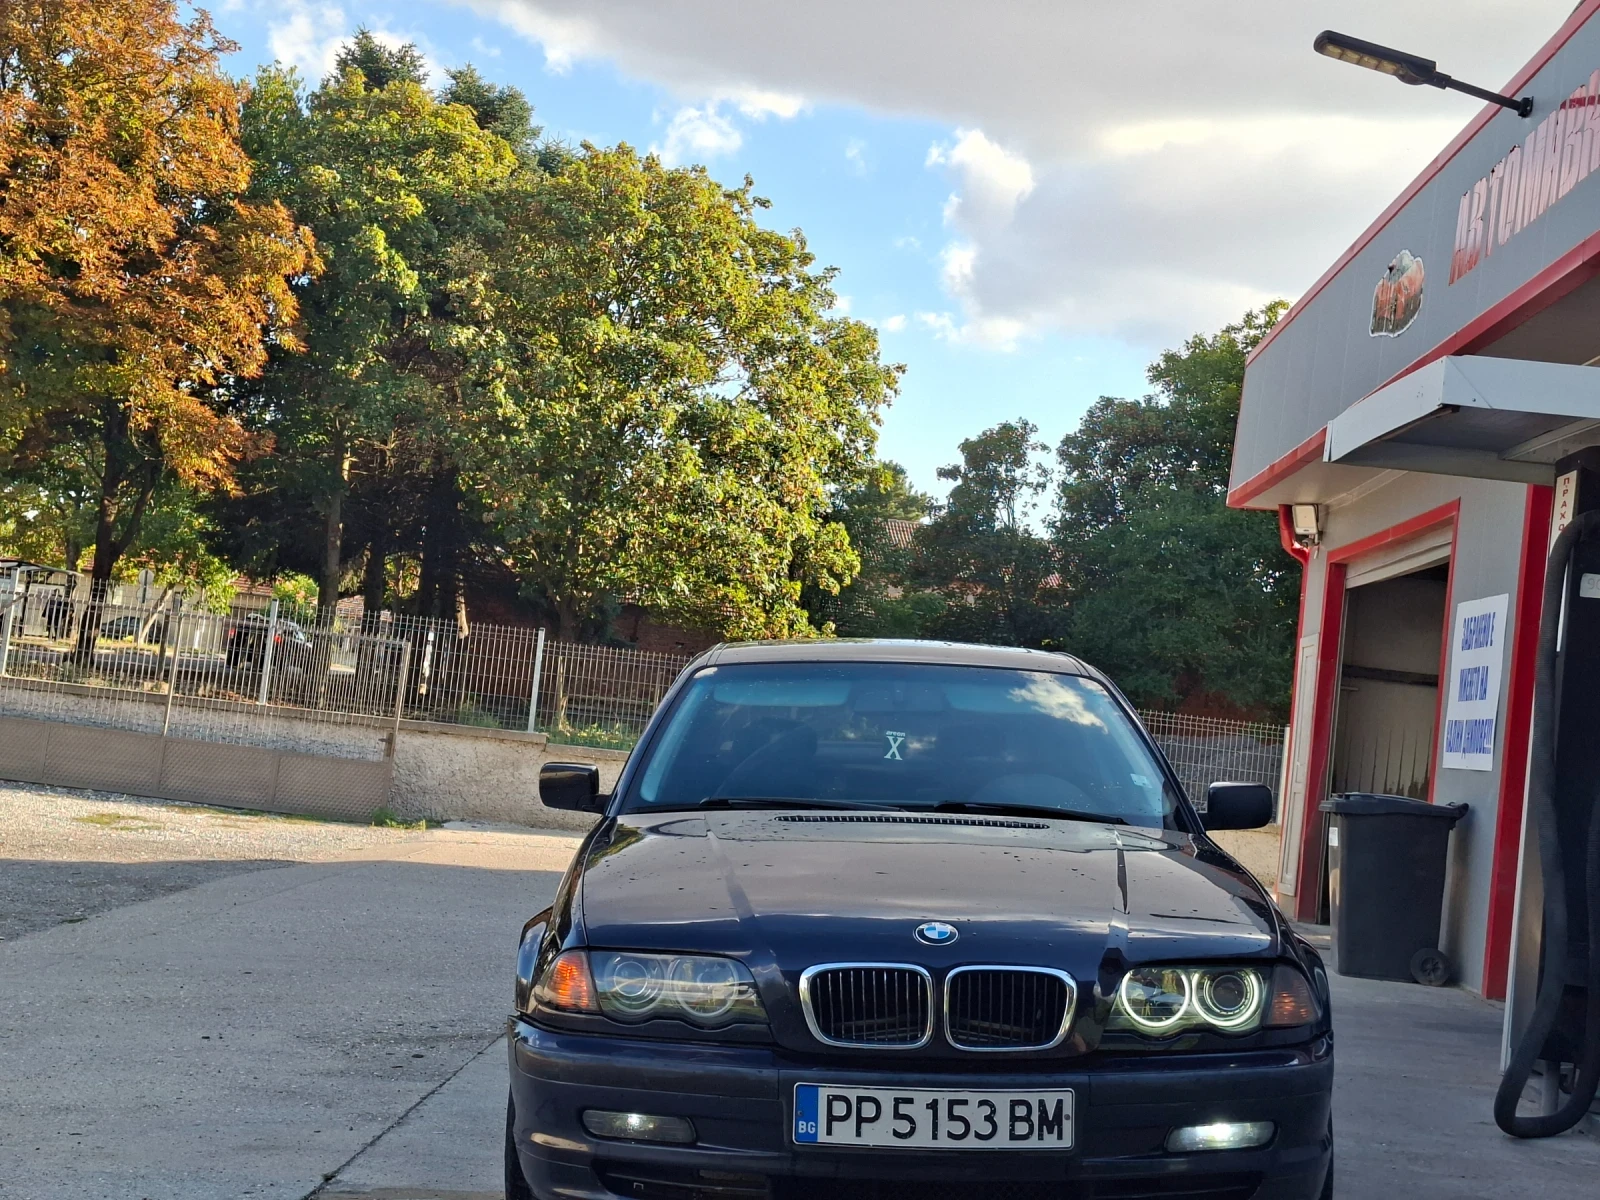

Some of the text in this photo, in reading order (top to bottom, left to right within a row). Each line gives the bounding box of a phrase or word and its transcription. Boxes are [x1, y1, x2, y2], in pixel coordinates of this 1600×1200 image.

[884, 735, 905, 760] X
[799, 1120, 816, 1134] BG
[826, 1094, 1064, 1141] PP 5153 BM
